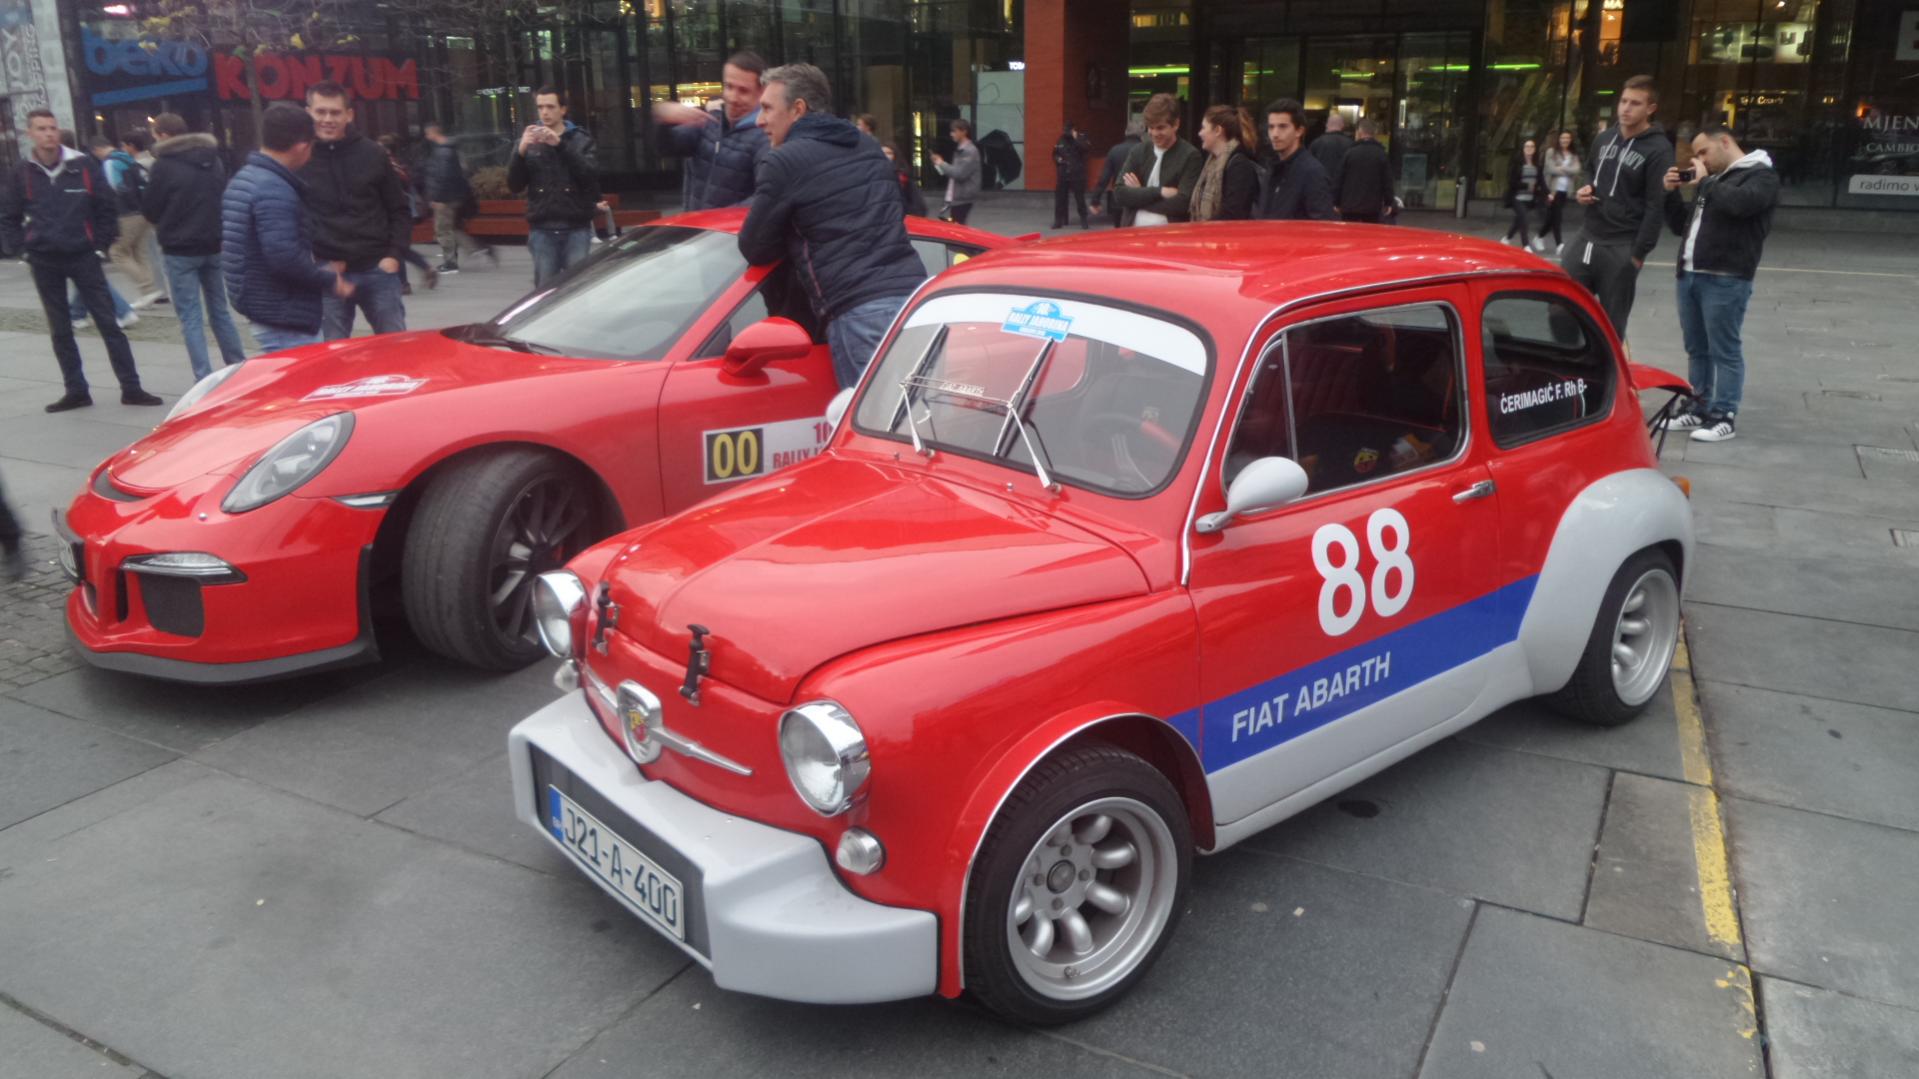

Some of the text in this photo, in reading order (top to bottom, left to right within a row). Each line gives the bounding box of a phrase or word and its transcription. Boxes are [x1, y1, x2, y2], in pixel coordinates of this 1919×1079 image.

[82, 23, 208, 76] beko
[213, 50, 420, 100] KONZUM
[1861, 179, 1910, 192] radimo
[1555, 384, 1565, 400] F.
[1564, 381, 1577, 398] Rh
[713, 430, 758, 478] 00
[773, 448, 810, 469] RALLY
[1311, 507, 1415, 637] 88
[1232, 651, 1391, 742] FIAT ABARTH
[565, 808, 677, 928] J21-A-400
